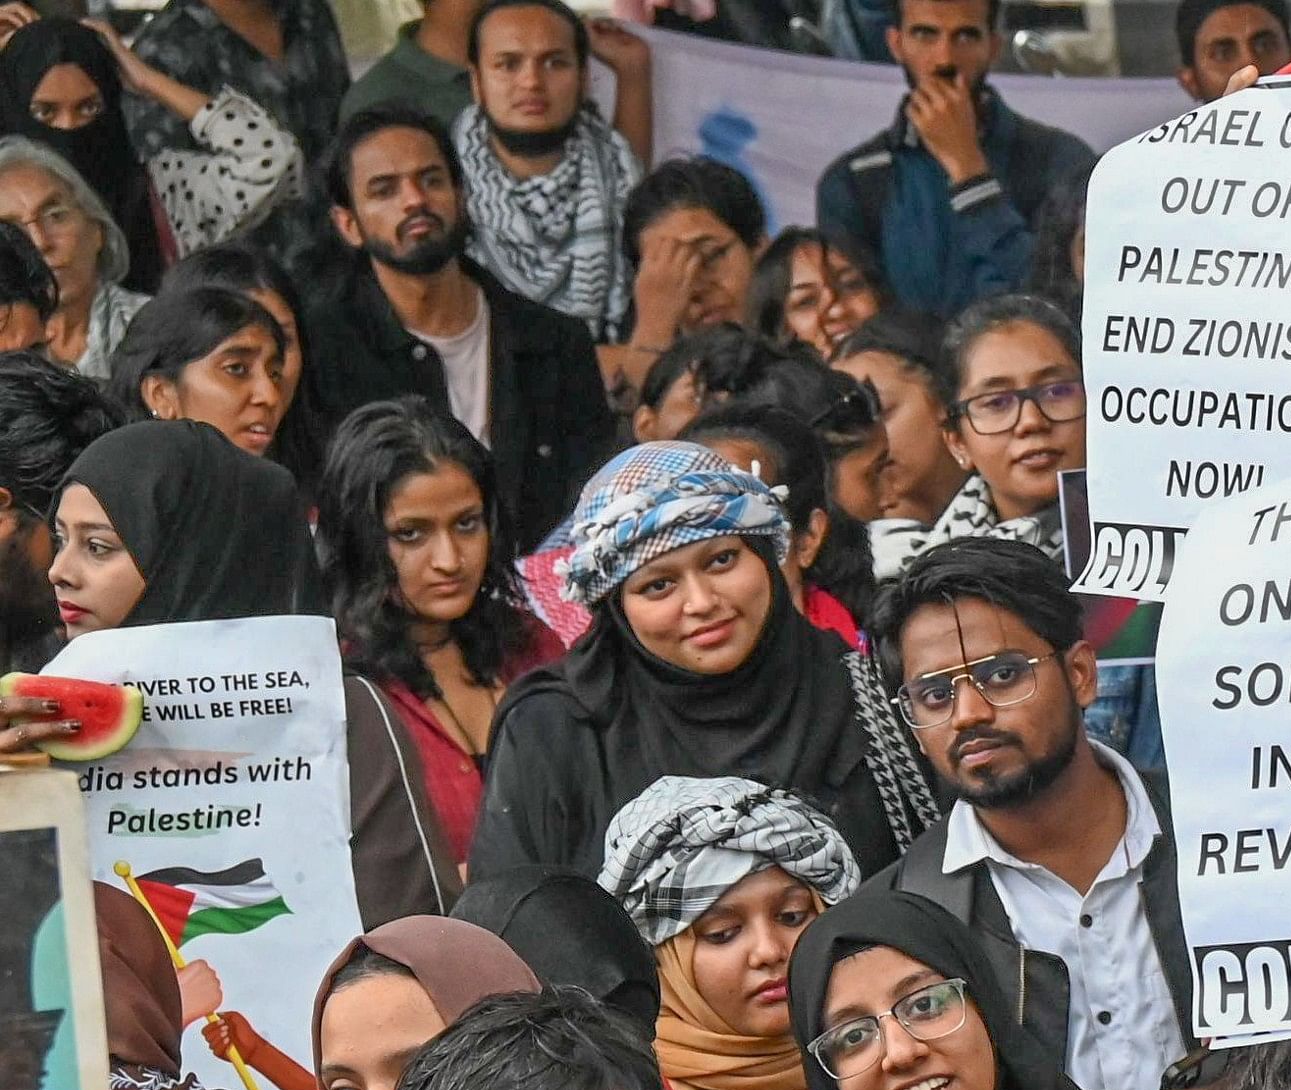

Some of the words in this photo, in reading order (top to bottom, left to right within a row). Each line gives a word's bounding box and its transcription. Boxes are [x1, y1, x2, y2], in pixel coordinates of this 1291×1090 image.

[1160, 176, 1247, 216] OUT
[1102, 315, 1175, 354] END
[186, 676, 216, 694] TO
[220, 673, 258, 692] THE
[264, 670, 310, 689] SEA,
[155, 703, 206, 722] WILL
[209, 701, 234, 719] BE
[239, 697, 293, 717] FREE!
[133, 761, 238, 790] stands
[247, 756, 312, 783] with
[107, 803, 262, 835] Palestine!
